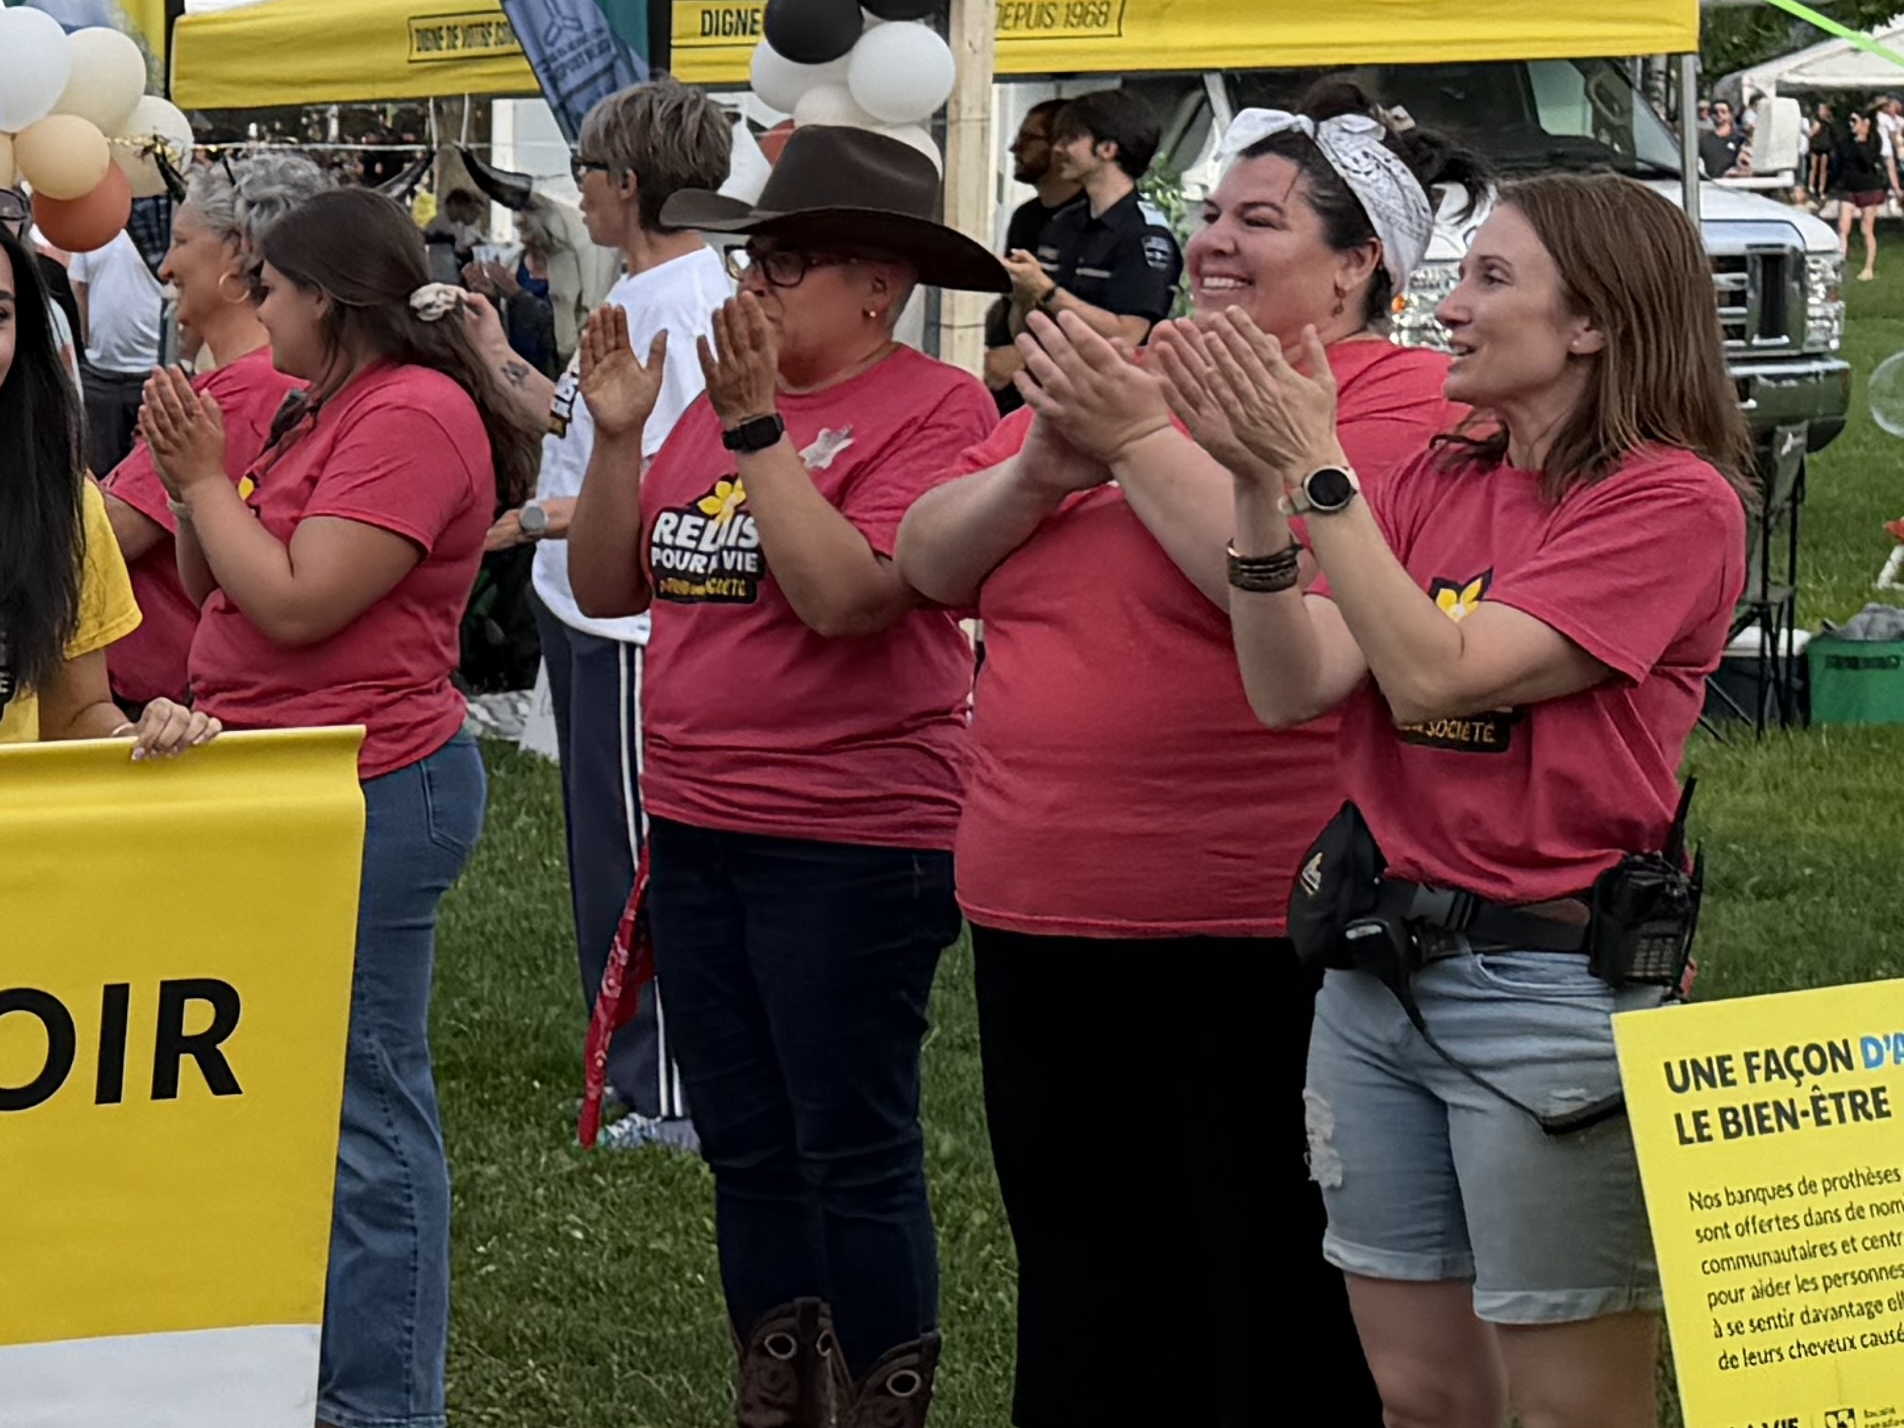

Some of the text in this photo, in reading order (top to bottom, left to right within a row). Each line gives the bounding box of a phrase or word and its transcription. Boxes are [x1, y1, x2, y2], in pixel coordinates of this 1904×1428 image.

[700, 8, 763, 37] DIGNE
[1063, 0, 1111, 29] 1968
[651, 546, 759, 574] POUR VIE
[1664, 1054, 1738, 1094] UNE
[1743, 1038, 1855, 1088] FAÇON
[1674, 1084, 1892, 1146] LE BIEN-ÊTRE
[1688, 1166, 1902, 1212] Nos banques de prothèses
[1695, 1197, 1904, 1243] sont offertes dans de nom
[1701, 1239, 1838, 1275] communautaires
[1841, 1235, 1859, 1255] et
[1707, 1286, 1745, 1313] pour
[1751, 1277, 1791, 1301] aider
[1794, 1274, 1819, 1295] les
[1712, 1317, 1724, 1338] à
[1727, 1319, 1745, 1337] se
[1749, 1307, 1794, 1334] sentir
[1800, 1299, 1884, 1326] davantage
[1718, 1348, 1739, 1370] de
[1741, 1343, 1785, 1368] leurs
[1788, 1334, 1857, 1360] cheveux
